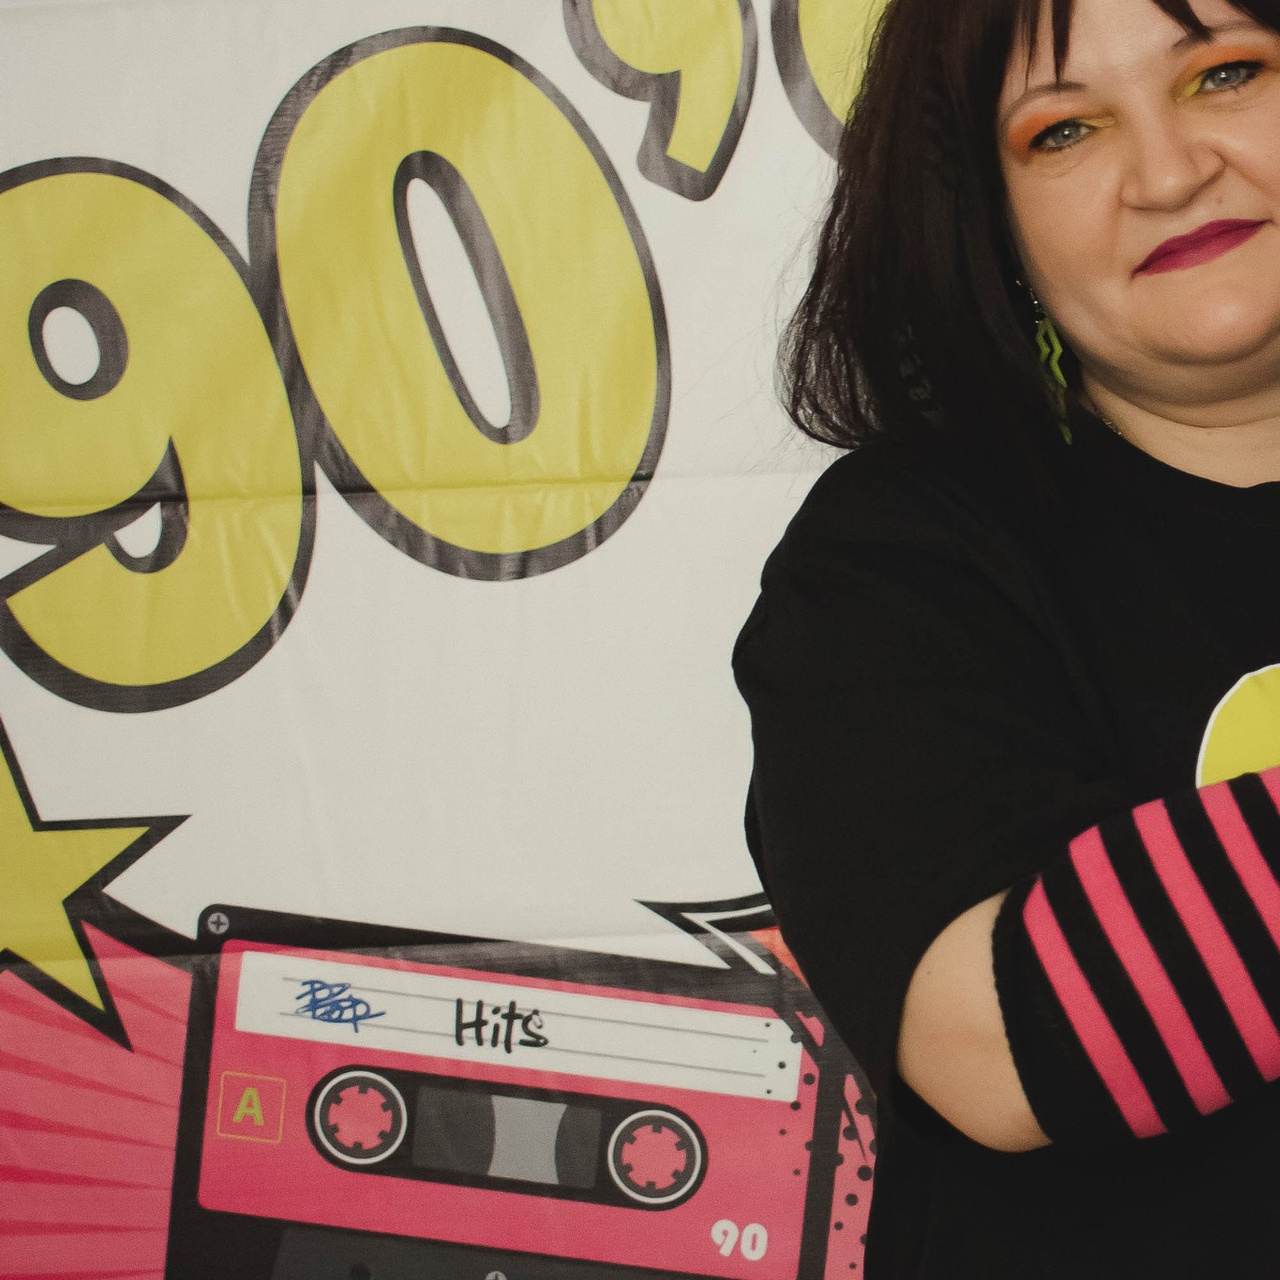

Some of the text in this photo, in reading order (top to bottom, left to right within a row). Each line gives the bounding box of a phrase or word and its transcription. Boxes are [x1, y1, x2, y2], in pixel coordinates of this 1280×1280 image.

[454, 998, 549, 1053] Hits
[233, 1088, 264, 1126] A
[711, 1219, 768, 1261] 90
